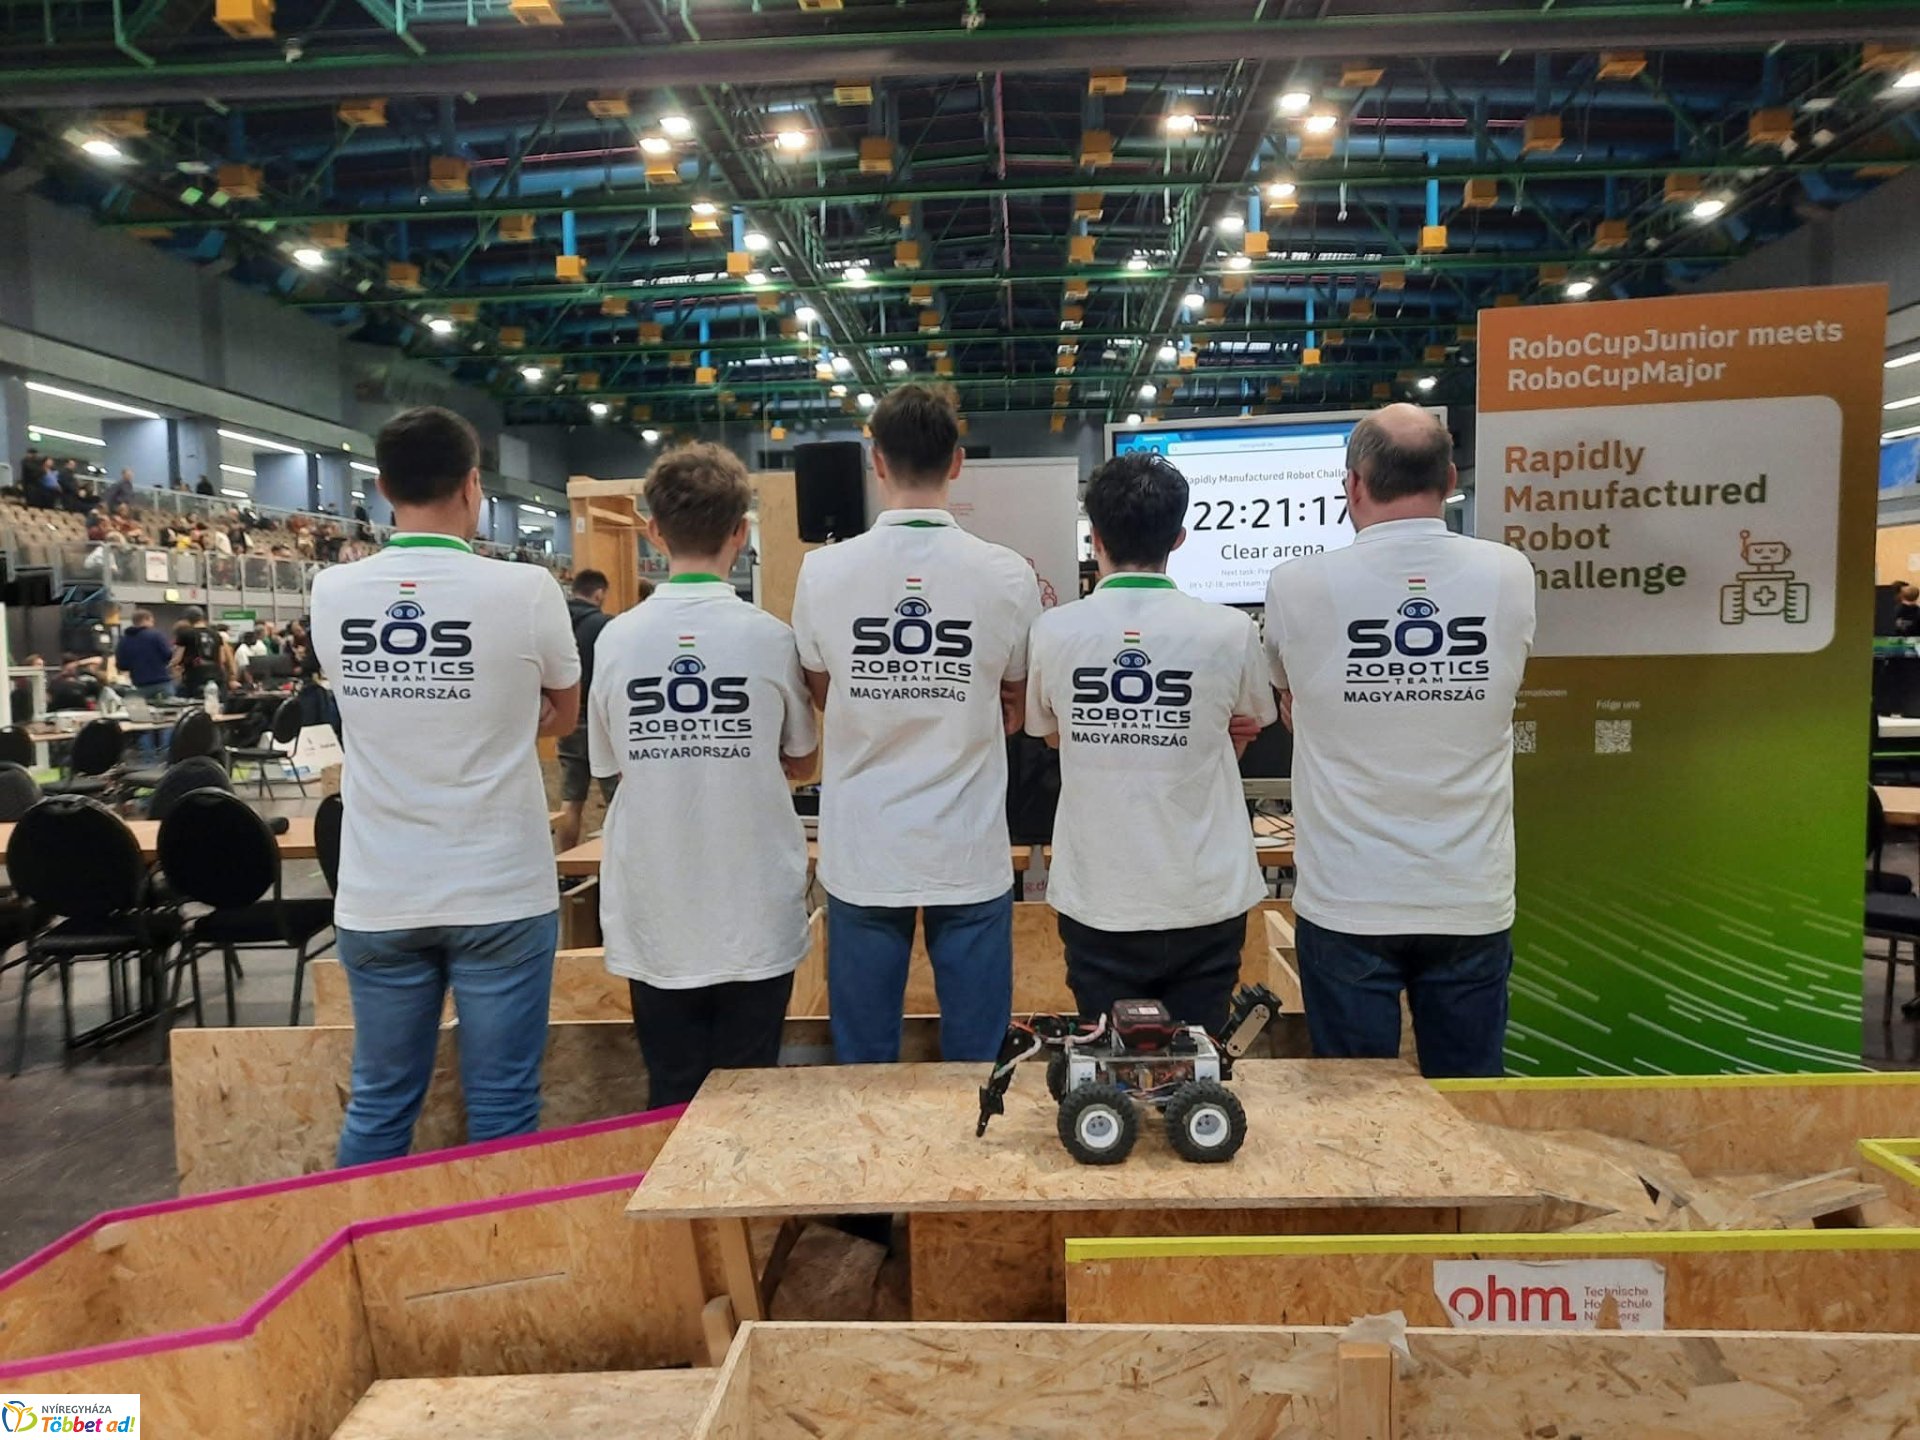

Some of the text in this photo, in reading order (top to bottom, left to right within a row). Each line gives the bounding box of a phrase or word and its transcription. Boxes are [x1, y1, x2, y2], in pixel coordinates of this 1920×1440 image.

[1508, 320, 1843, 360] RoboCupJunior meets
[1508, 358, 1727, 392] RoboCupMajor
[1504, 440, 1646, 478] Rapidly
[1219, 472, 1285, 483] Manufactured
[1286, 471, 1314, 480] Robot
[1317, 469, 1346, 478] Challe
[1504, 474, 1767, 512] Manufactured
[1193, 495, 1348, 531] 22:21:17
[1504, 522, 1610, 551] Robot
[1221, 544, 1324, 560] Clear arena
[1533, 560, 1686, 595] hallenge
[340, 618, 473, 657] SOS
[851, 617, 973, 658] SOS
[1347, 616, 1487, 659] SOS
[342, 659, 475, 675] ROBOTICS
[851, 660, 972, 677] ROBOTICS
[1346, 660, 1489, 677] ROBOTICS
[1072, 667, 1193, 707] SOS
[1394, 677, 1443, 685] TEAM
[343, 685, 471, 700] MAGYARORSZÁG
[626, 676, 750, 717] SOS
[850, 686, 966, 702] MAGYARORSZÁG
[1344, 687, 1486, 703] MAGYARORSZÁG
[1071, 707, 1191, 723] ROBOTICS
[629, 718, 752, 735] ROBOTICS
[1071, 731, 1188, 747] MAGYARORSZÁG
[629, 744, 751, 760] MAGYARORSZÁG
[1448, 1274, 1577, 1322] ohm
[1584, 1286, 1649, 1297] Technische
[1584, 1299, 1653, 1309] Hochule
